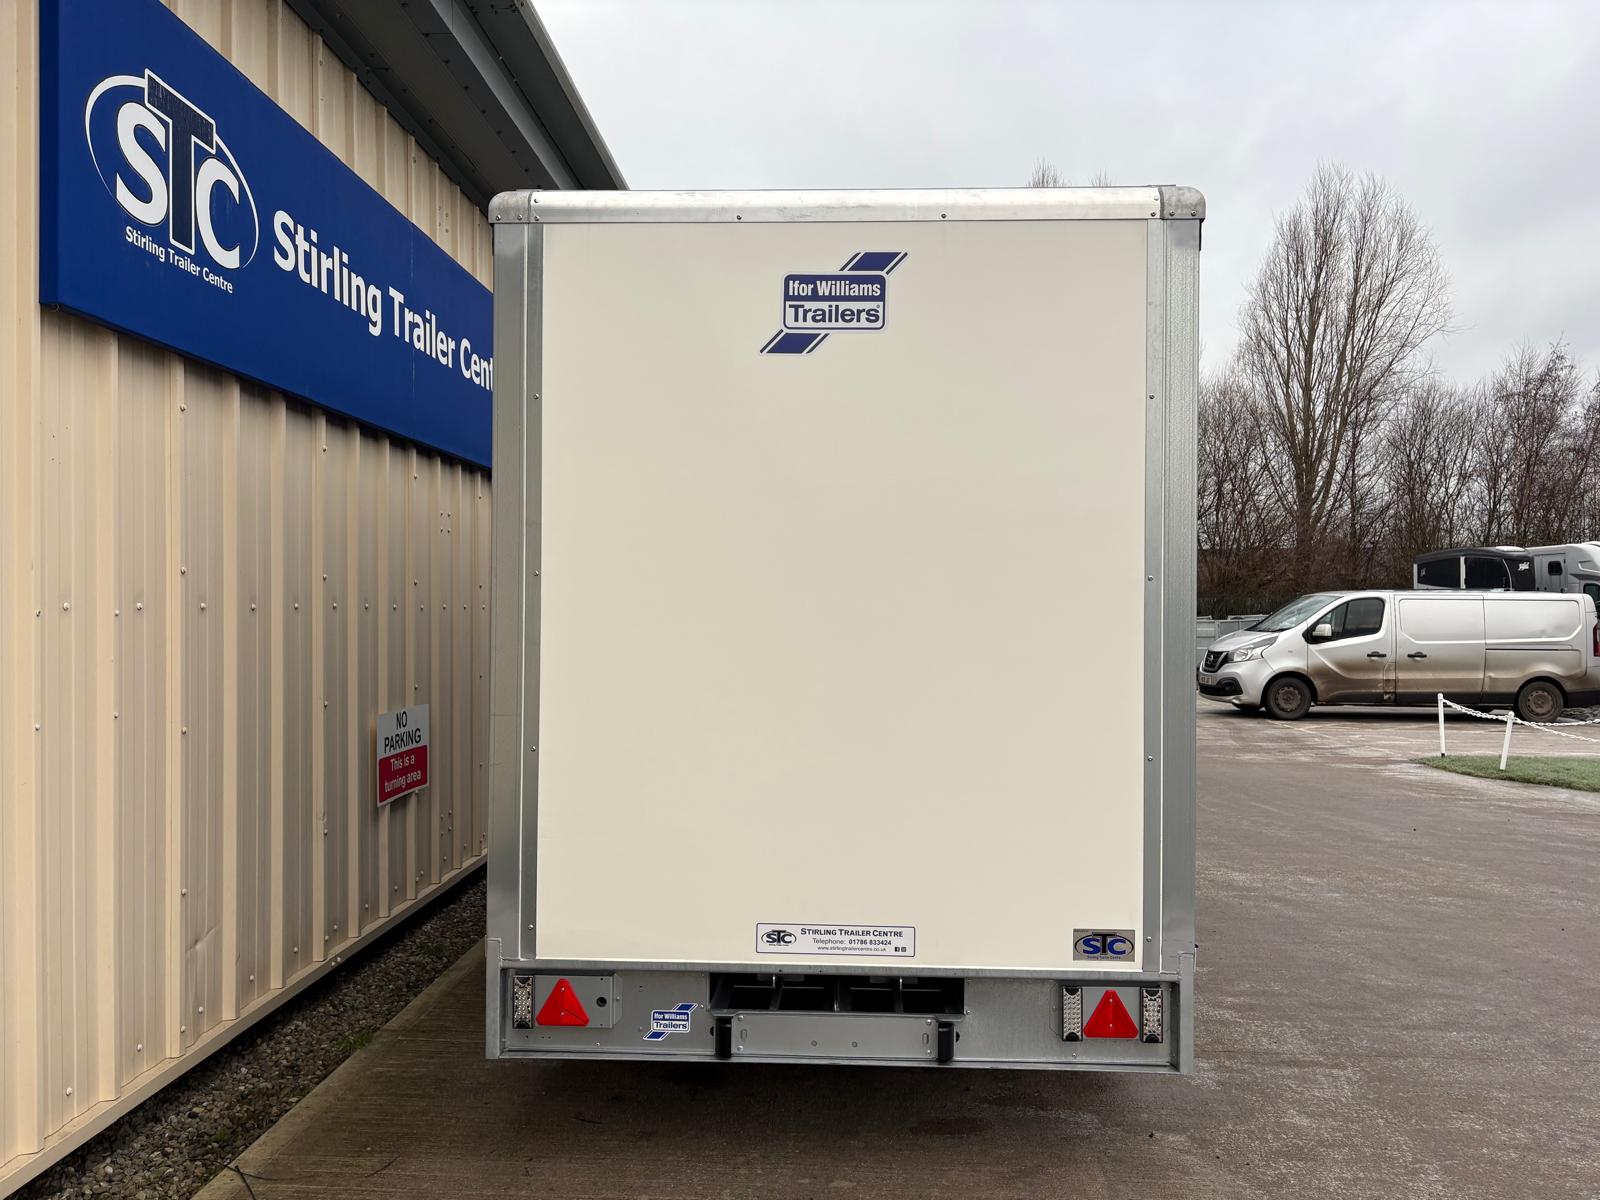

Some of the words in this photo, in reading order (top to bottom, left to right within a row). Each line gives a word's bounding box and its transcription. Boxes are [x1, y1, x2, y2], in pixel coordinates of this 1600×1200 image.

[116, 68, 240, 270] STC
[125, 225, 166, 262] Stirling
[168, 248, 200, 276] Trailer
[202, 267, 233, 294] Centre
[273, 210, 382, 337] Stirling
[388, 286, 456, 368] Trailer
[788, 280, 813, 296] Ifor
[816, 280, 881, 296] Williams
[788, 304, 880, 323] Trailers
[396, 711, 408, 730] NO
[384, 728, 422, 754] PARKING
[390, 756, 403, 772] This
[403, 755, 410, 766] is
[410, 754, 415, 765] a
[384, 775, 406, 792] turning
[407, 770, 422, 783] area
[766, 930, 792, 944] STC
[800, 928, 837, 936] STIRLING
[838, 929, 870, 937] TRAILER
[872, 929, 903, 938] CENTRE
[812, 938, 846, 946] Telephone:
[1082, 932, 1126, 955] STC
[654, 1021, 687, 1029] Trailers
